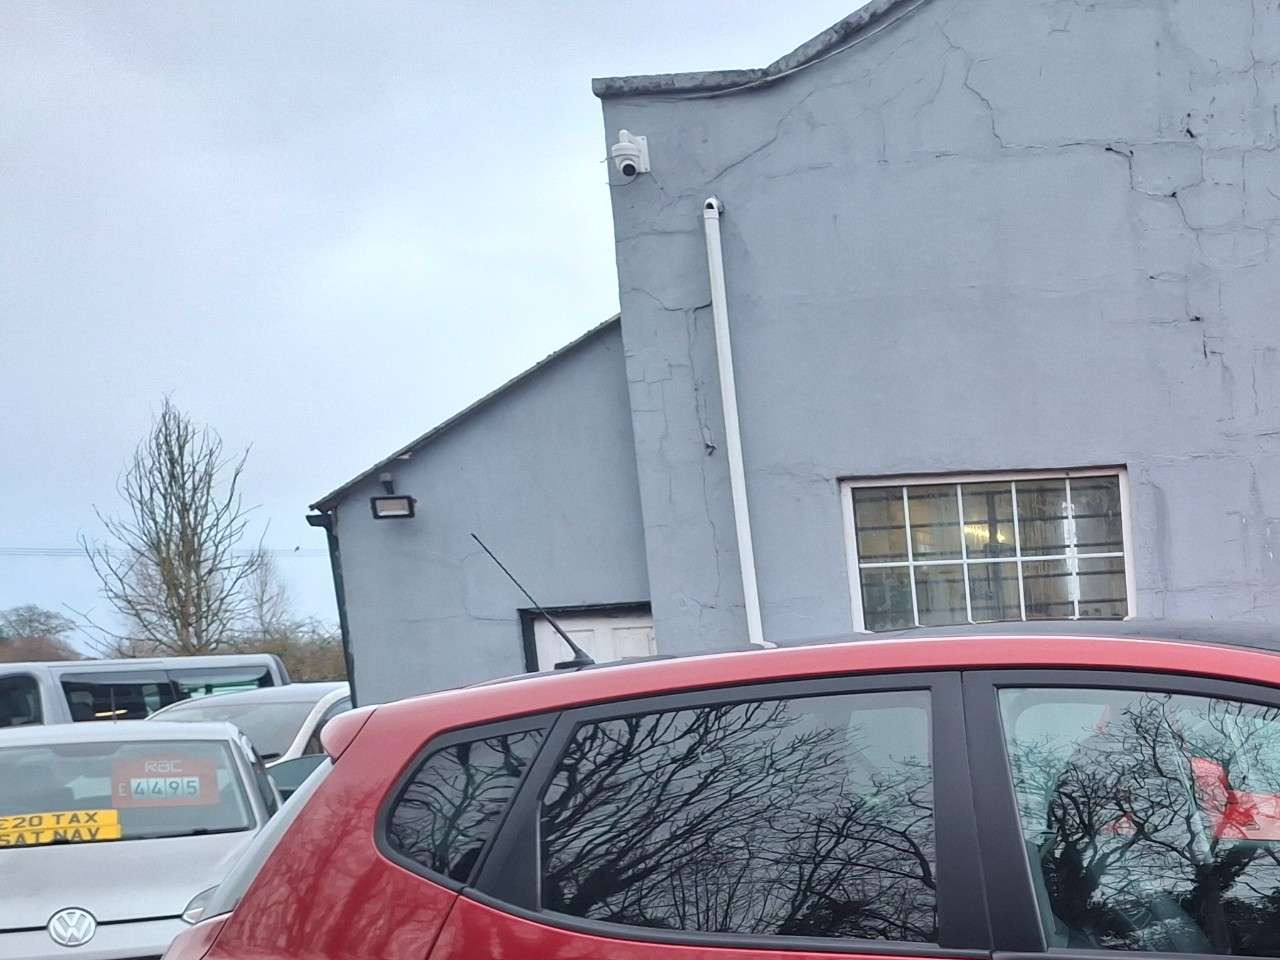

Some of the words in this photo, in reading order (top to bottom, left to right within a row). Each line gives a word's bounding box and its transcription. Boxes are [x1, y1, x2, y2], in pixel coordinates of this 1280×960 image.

[52, 811, 99, 826] TAX
[0, 830, 45, 846] SAT
[53, 827, 100, 843] NAV
